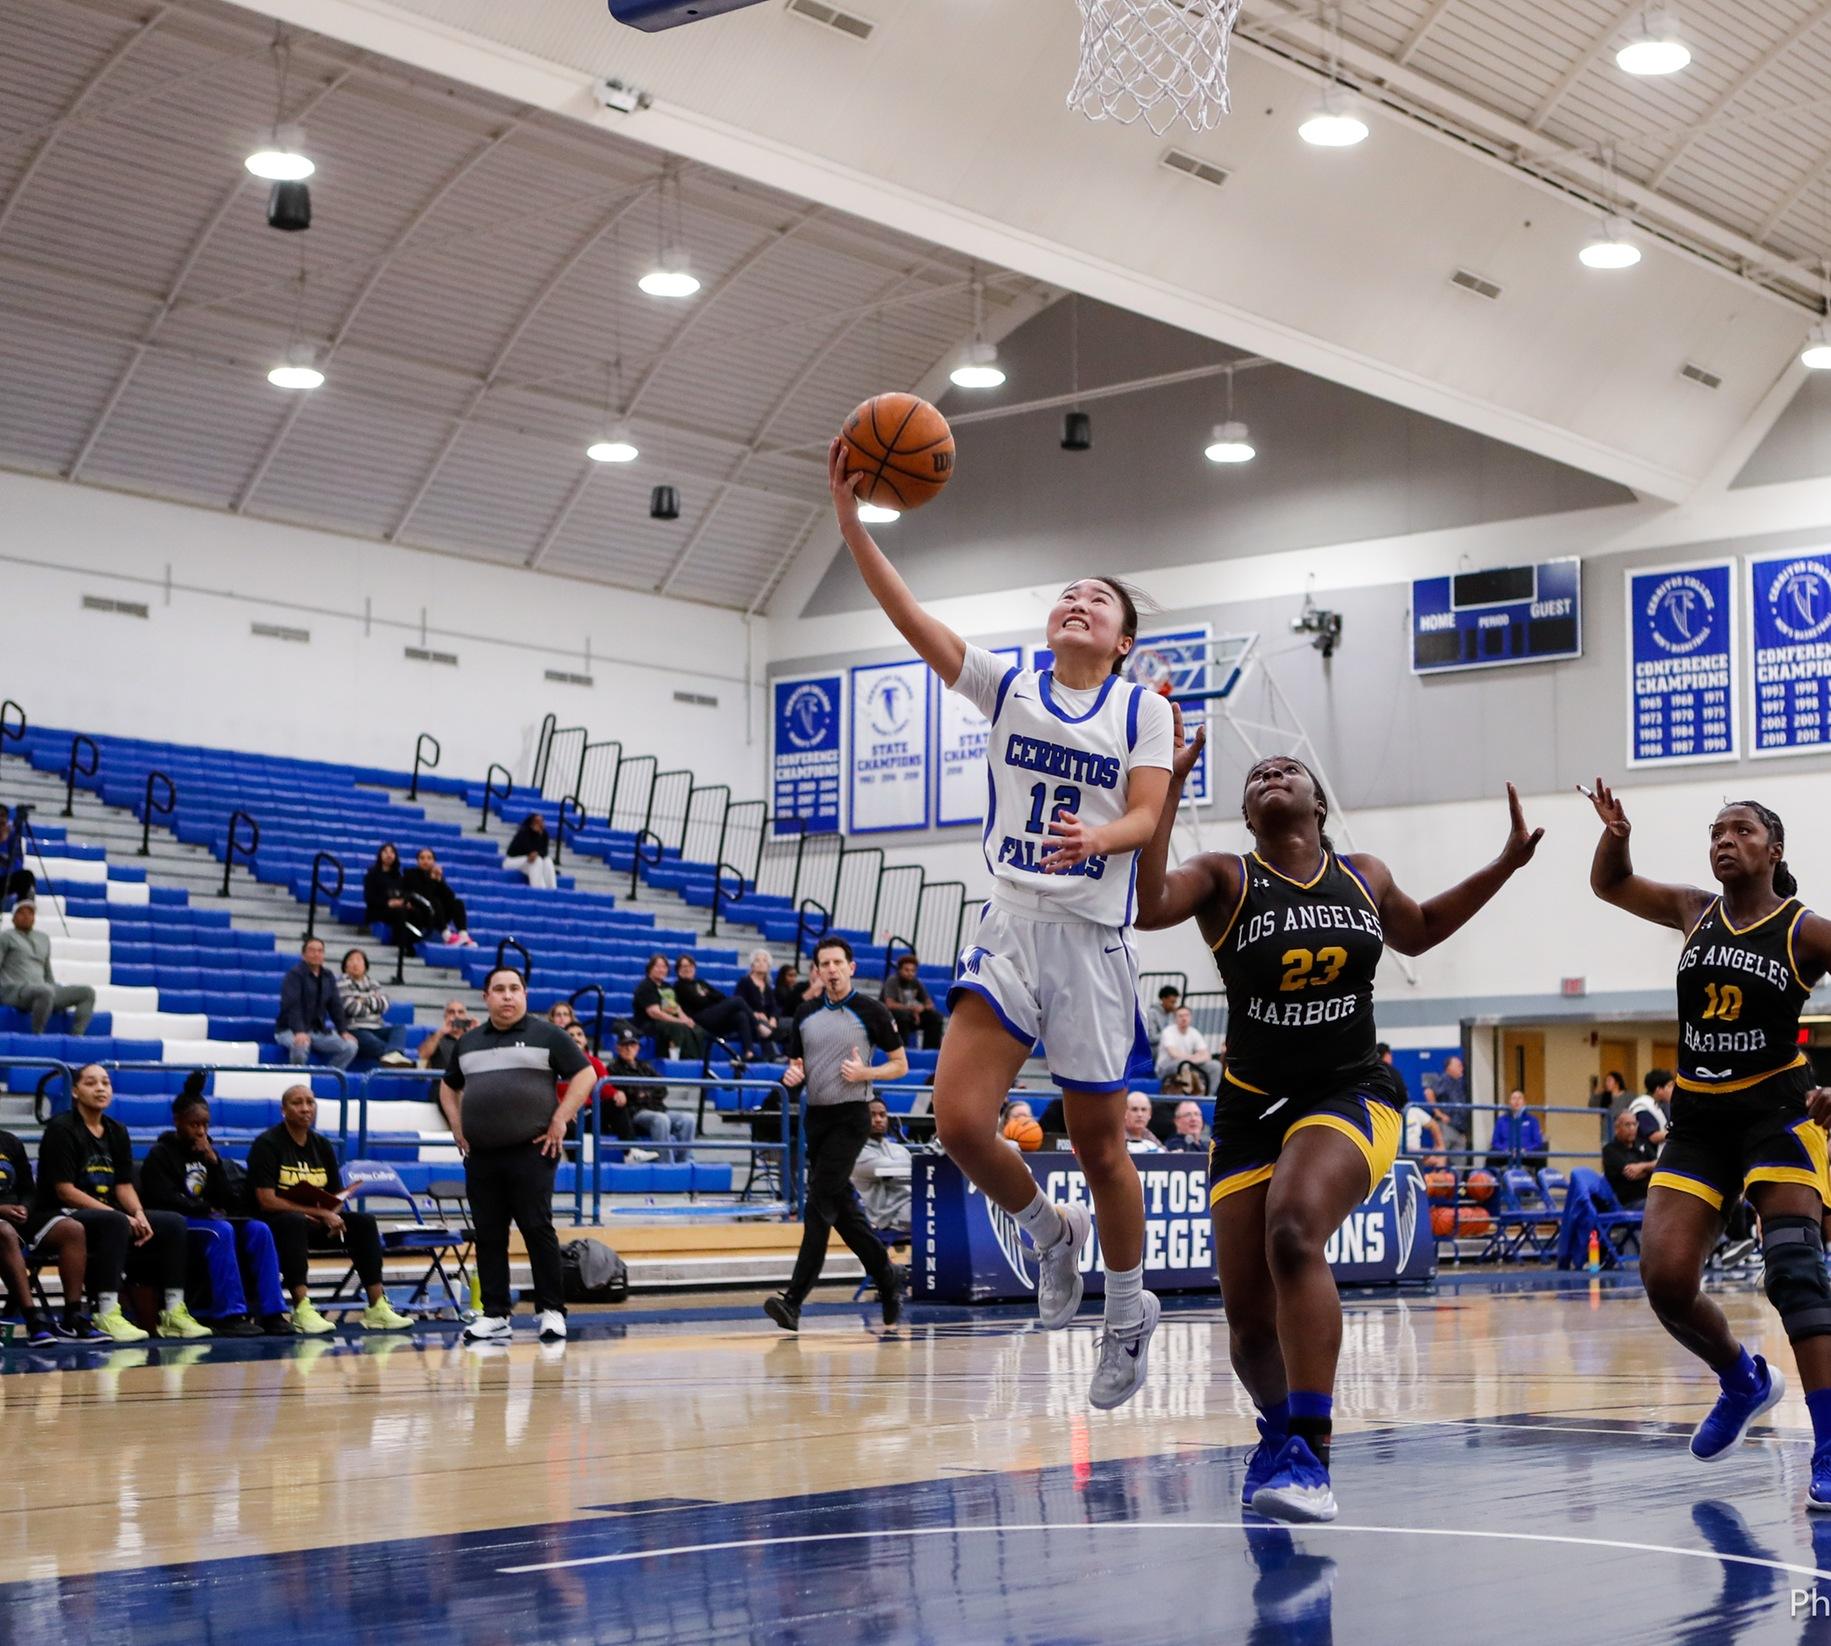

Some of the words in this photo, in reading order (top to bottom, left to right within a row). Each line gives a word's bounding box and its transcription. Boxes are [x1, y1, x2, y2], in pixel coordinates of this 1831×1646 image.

[1420, 612, 1456, 631] HOME
[1478, 614, 1509, 629] PERIOD
[1530, 599, 1572, 618] GUEST
[1636, 653, 1728, 677] CONFERENCE
[1636, 670, 1728, 695] CHAMPIONS
[872, 742, 908, 756] STATE
[1762, 731, 1787, 747] 2010
[858, 754, 922, 771] CHAMPIONS
[1005, 733, 1120, 789] CERRITOS
[1025, 782, 1081, 836] 12
[1237, 911, 1275, 952] LOS
[1283, 905, 1383, 942] ANGELES
[1279, 946, 1348, 992] 23
[1678, 946, 1700, 974] OS
[1702, 945, 1789, 992] ANGELES
[1247, 994, 1357, 1026] HARBOR
[1701, 982, 1743, 1021] 10
[926, 1165, 937, 1291] FALCONS
